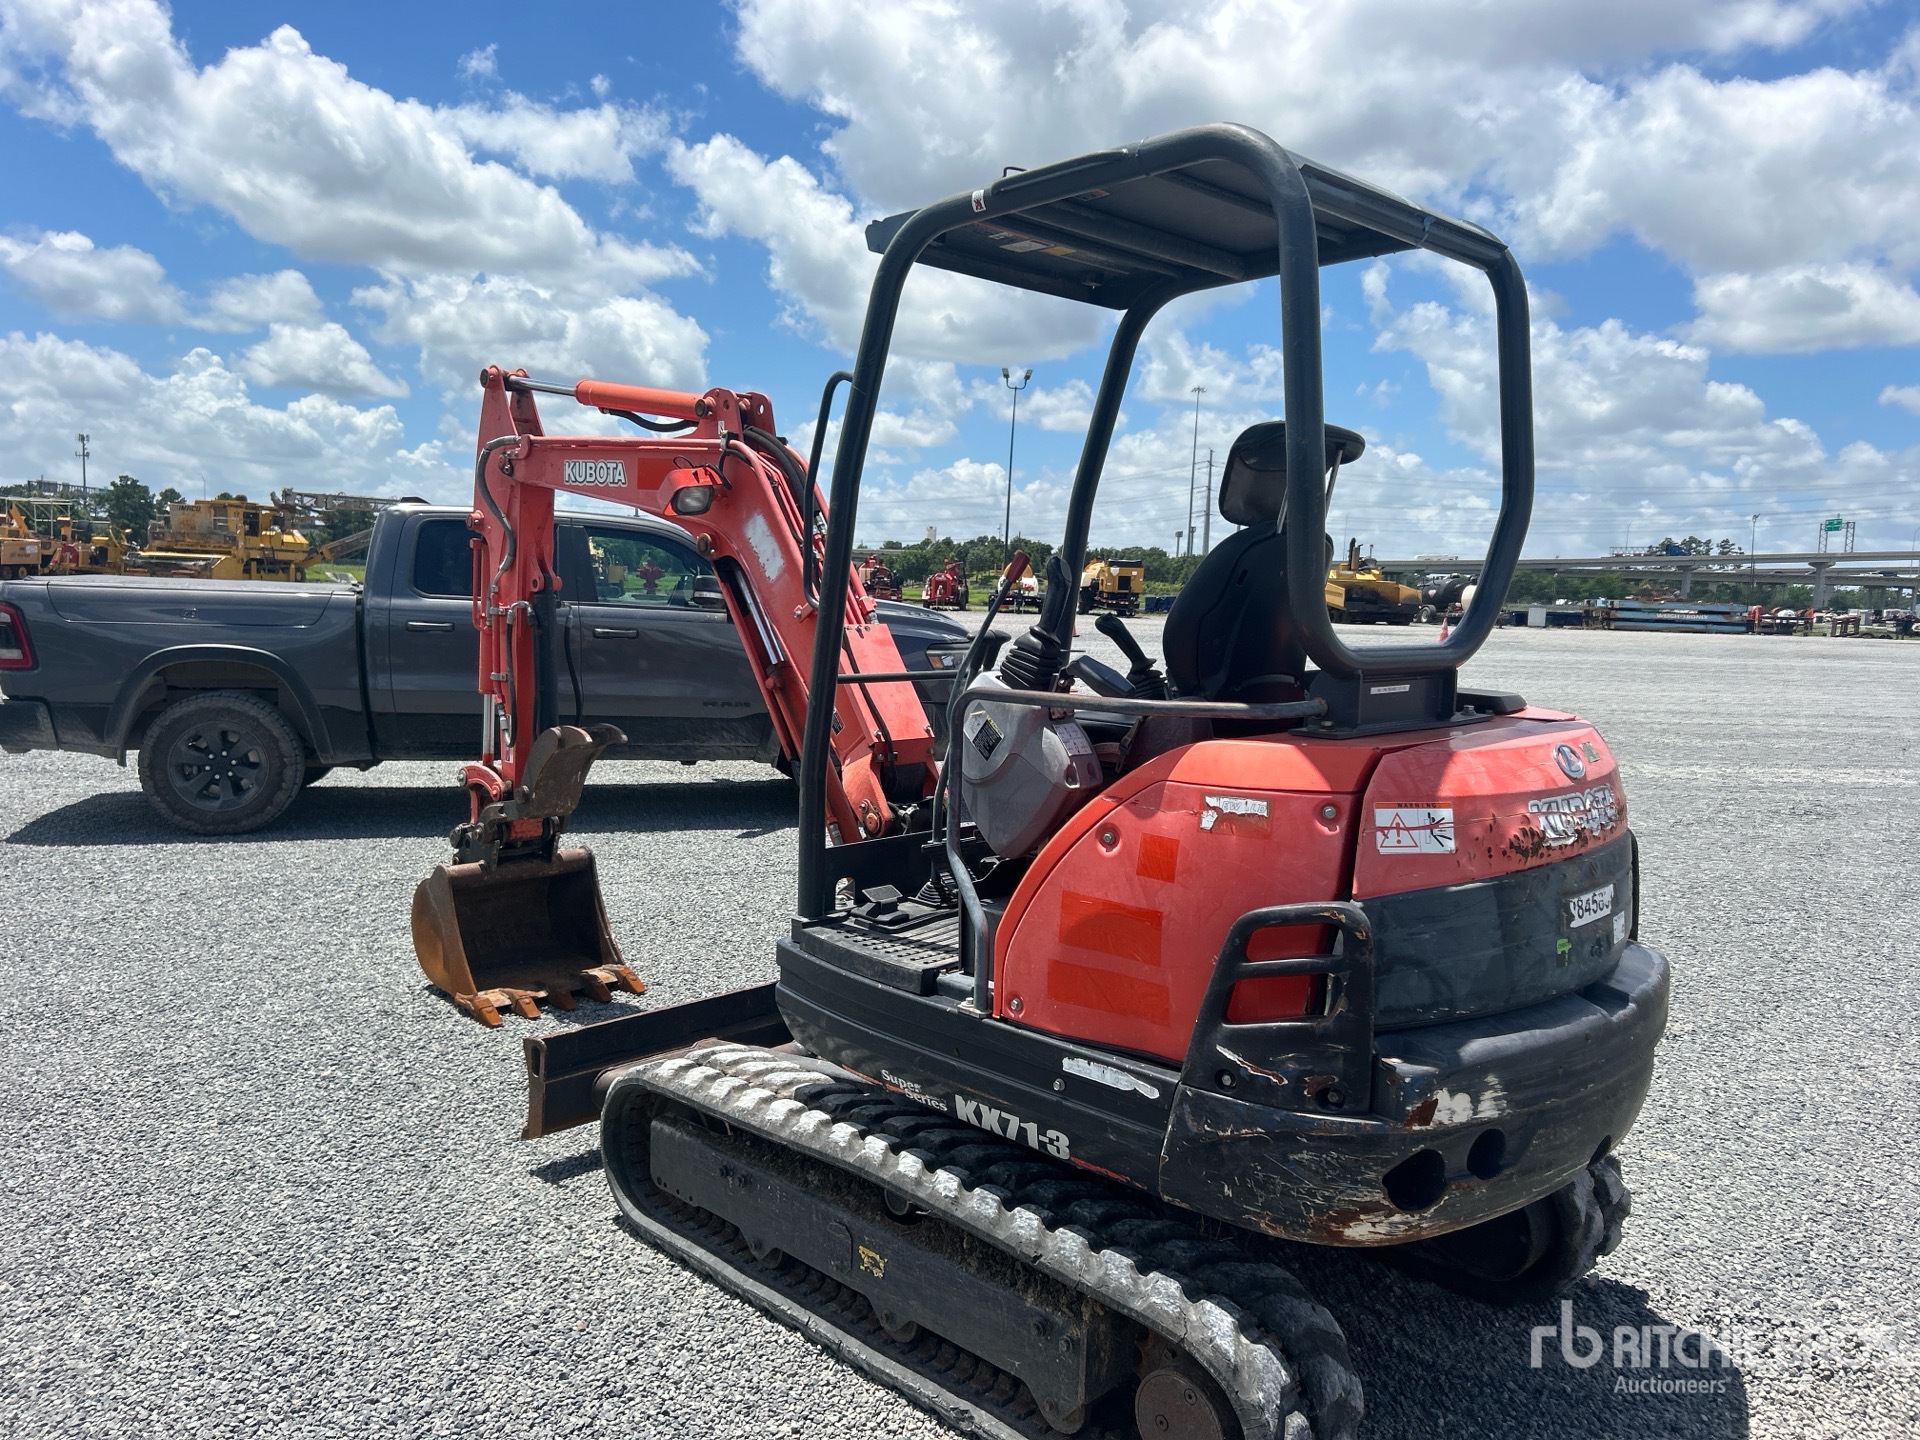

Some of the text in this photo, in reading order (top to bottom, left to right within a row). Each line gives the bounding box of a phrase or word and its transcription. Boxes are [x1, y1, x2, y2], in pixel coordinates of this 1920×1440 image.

[564, 460, 627, 486] KUBOTA
[881, 1069, 922, 1092] Super
[905, 1087, 948, 1112] Series
[954, 1094, 1071, 1160] KX71-3
